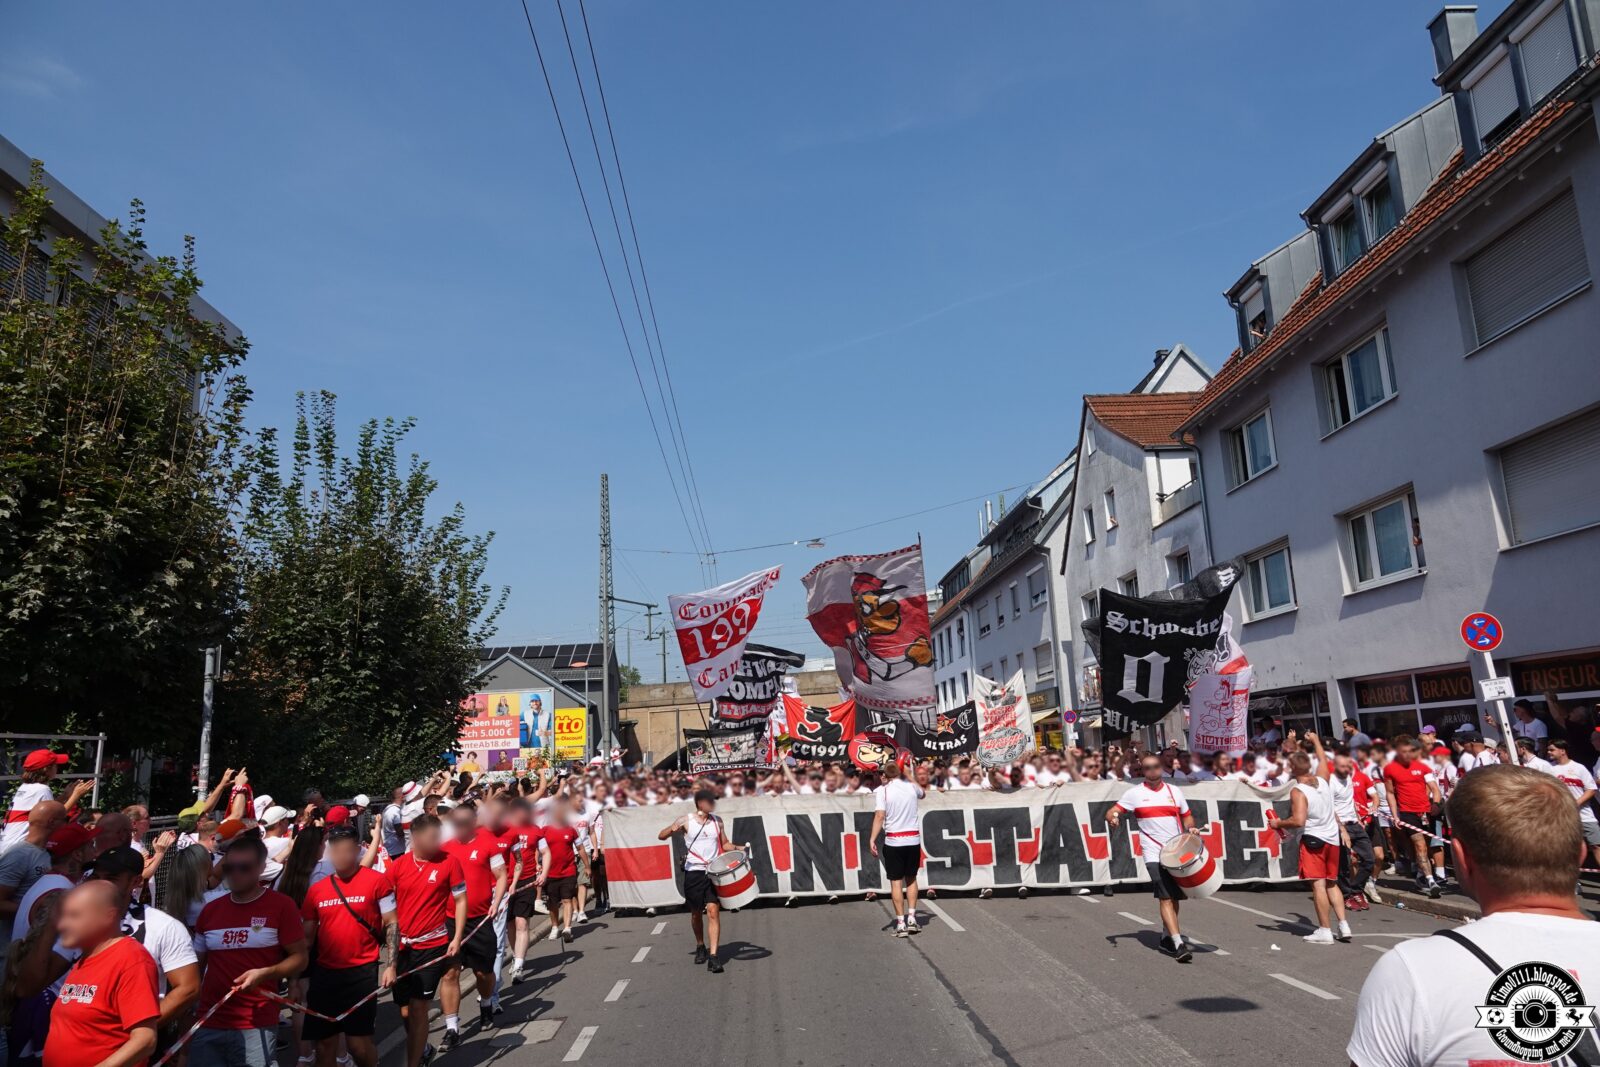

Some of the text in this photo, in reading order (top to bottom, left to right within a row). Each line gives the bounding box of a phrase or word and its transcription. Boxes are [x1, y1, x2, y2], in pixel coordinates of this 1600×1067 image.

[1105, 610, 1222, 640] Schwabe
[1362, 685, 1409, 705] BARBER
[1422, 676, 1472, 699] BRAVO
[480, 729, 505, 737] 5.000
[555, 716, 584, 735] tto
[462, 741, 511, 749] nteAb18.de
[791, 741, 846, 757] CC1997
[923, 734, 968, 751] ULTRAS
